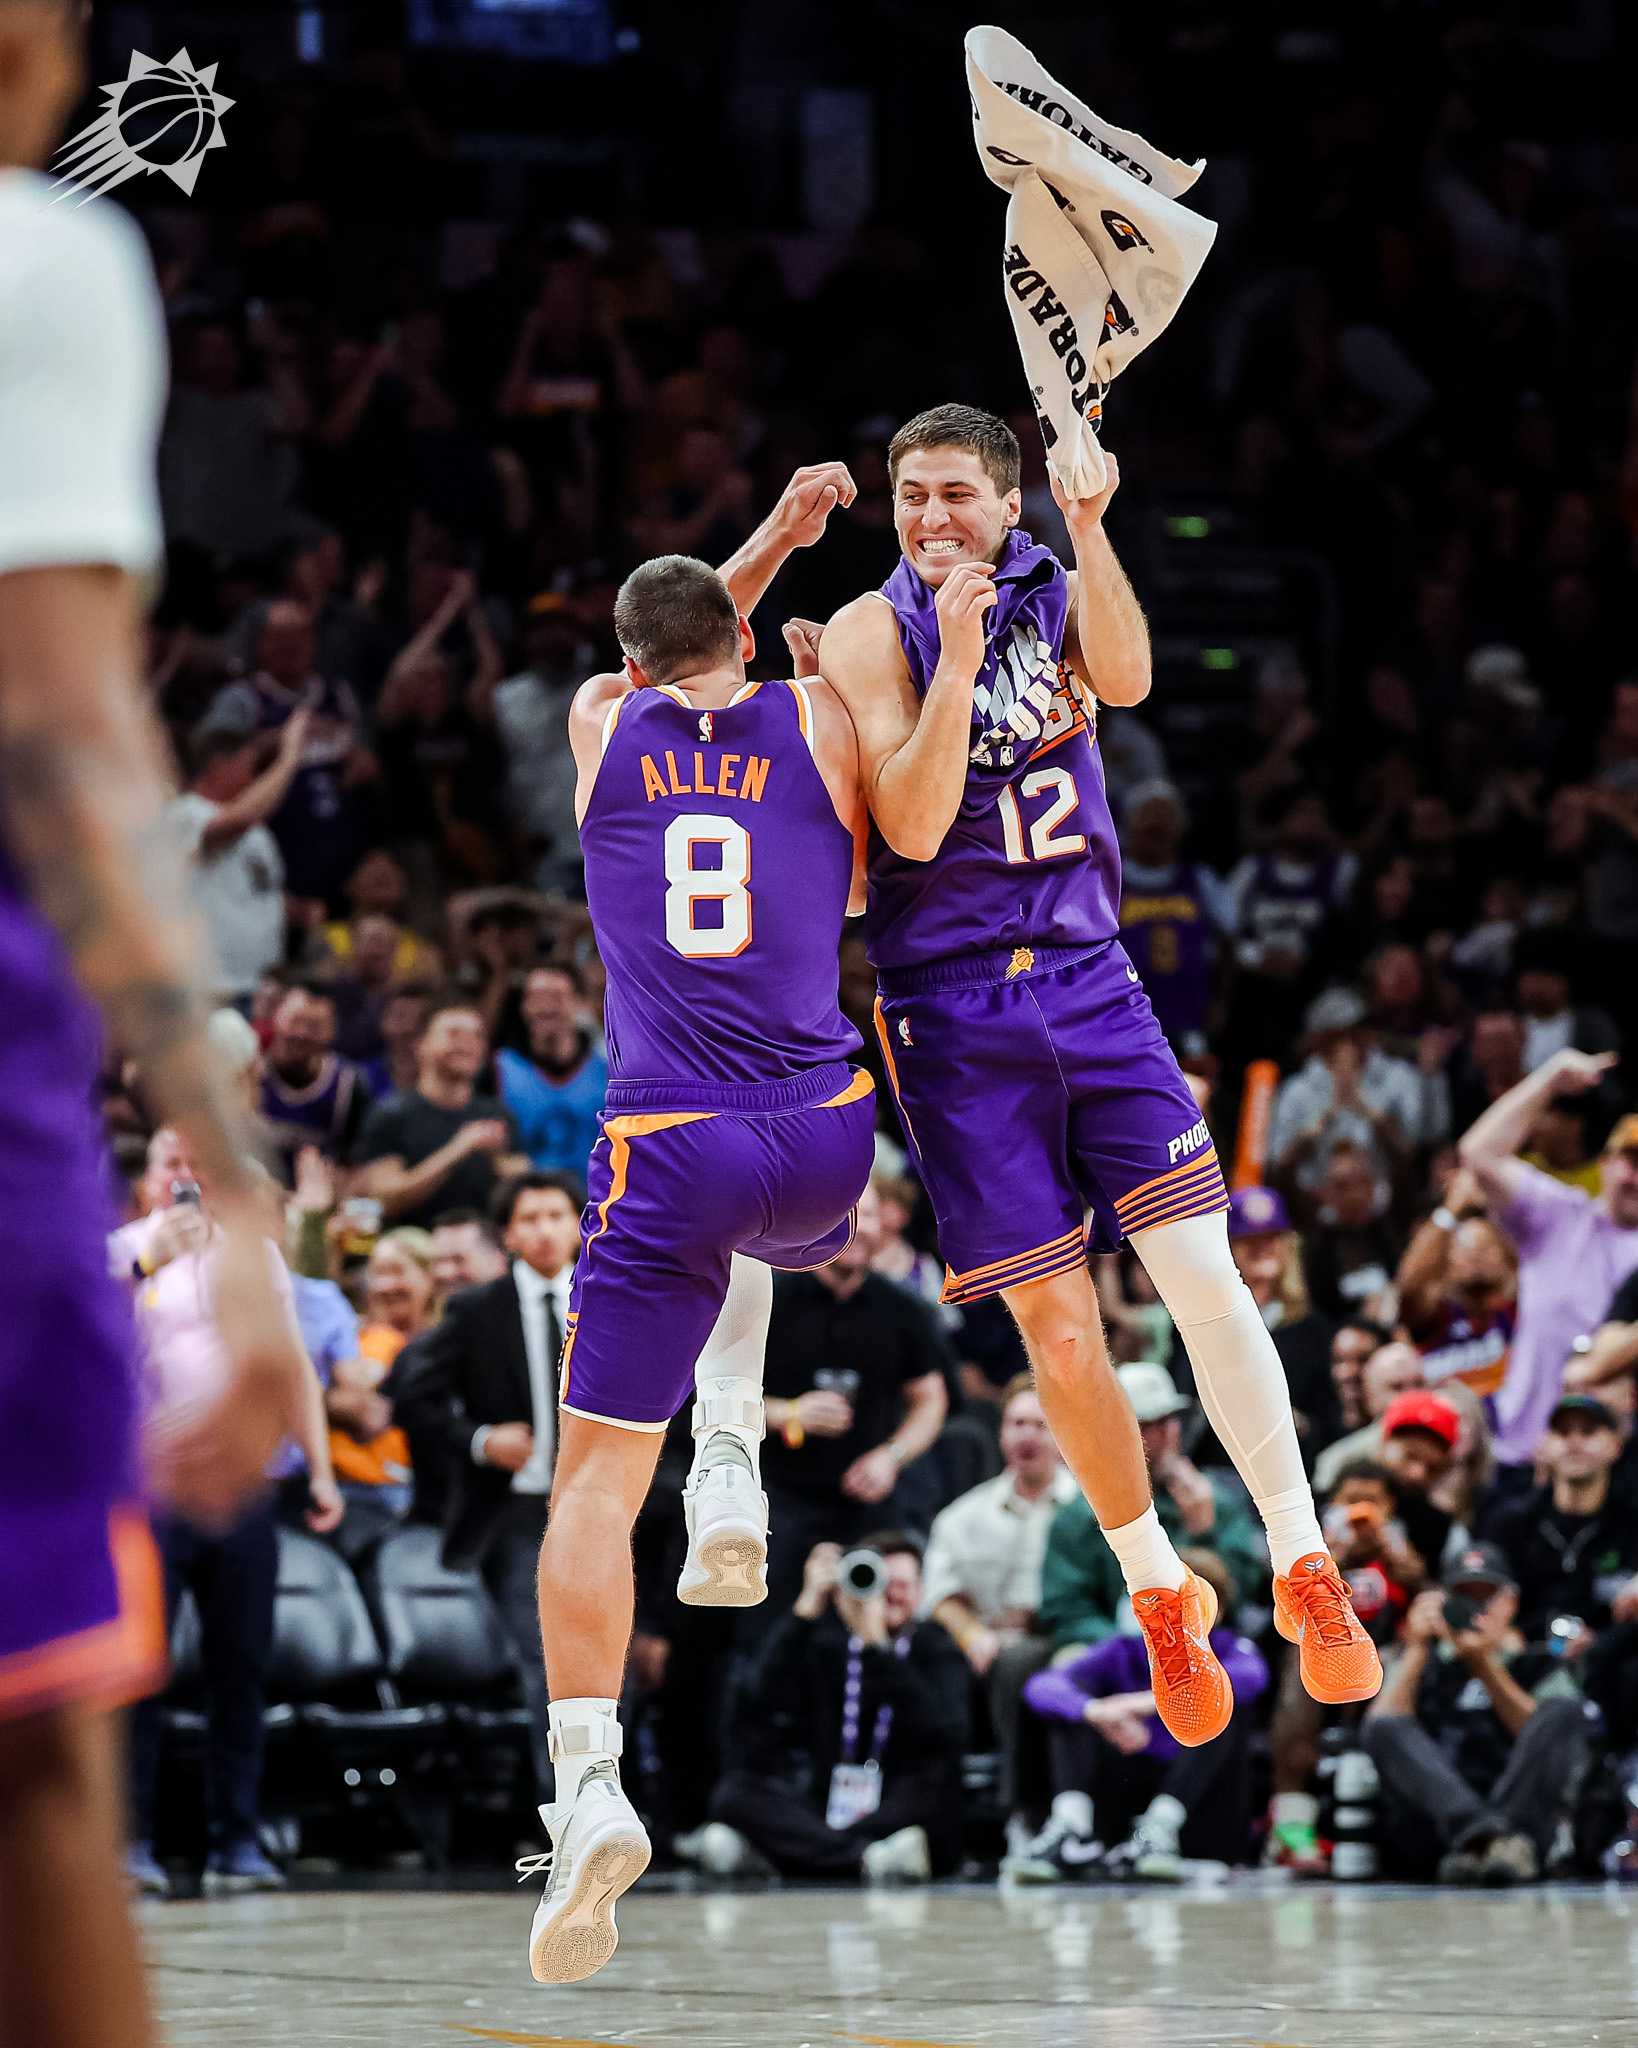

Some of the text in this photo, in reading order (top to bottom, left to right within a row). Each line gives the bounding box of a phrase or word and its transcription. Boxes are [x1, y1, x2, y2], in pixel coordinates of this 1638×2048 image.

[640, 750, 771, 803] ALLEN
[997, 766, 1087, 864] 12
[664, 813, 753, 959] 8
